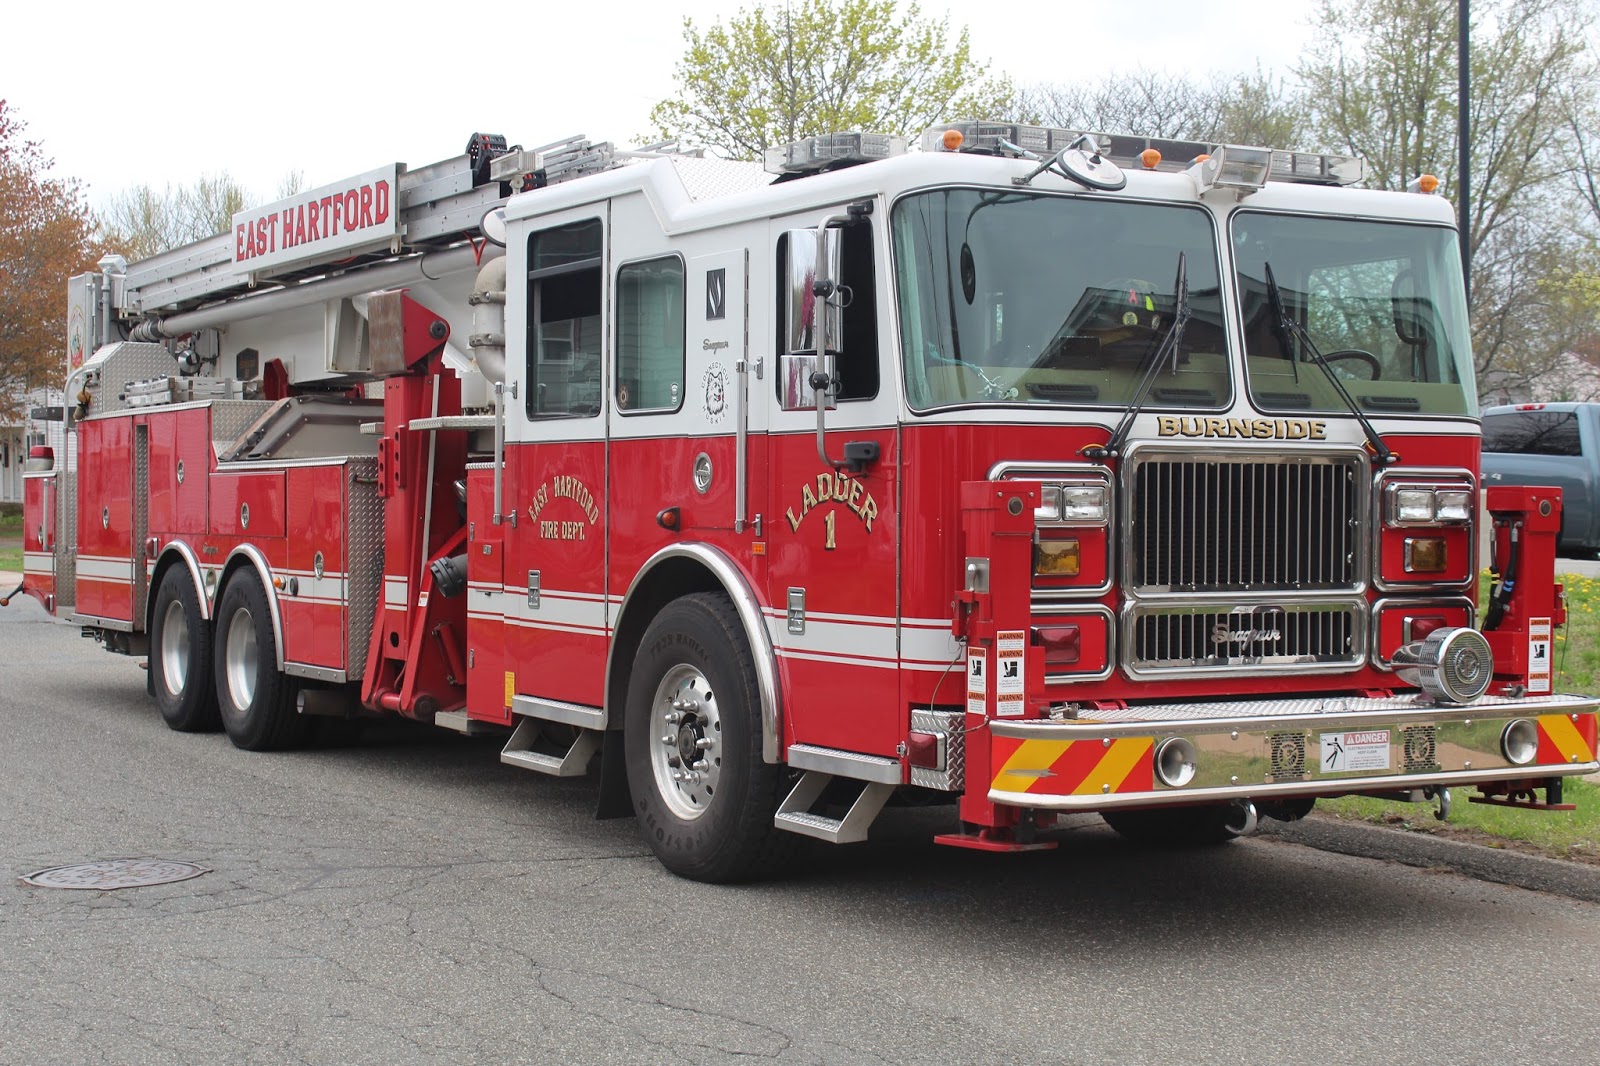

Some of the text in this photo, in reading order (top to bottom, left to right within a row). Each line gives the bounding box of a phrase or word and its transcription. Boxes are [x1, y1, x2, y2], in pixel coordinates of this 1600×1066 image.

[236, 179, 389, 262] EAST HARTFORD
[701, 361, 730, 389] CONNECTICUT
[1157, 416, 1327, 440] BURNSIDE
[527, 475, 599, 526] EAST HARTFORD
[785, 471, 879, 534] LADDER
[540, 520, 585, 541] FIRE DEPT.
[824, 509, 836, 550] 1
[1355, 733, 1387, 744] DANGER
